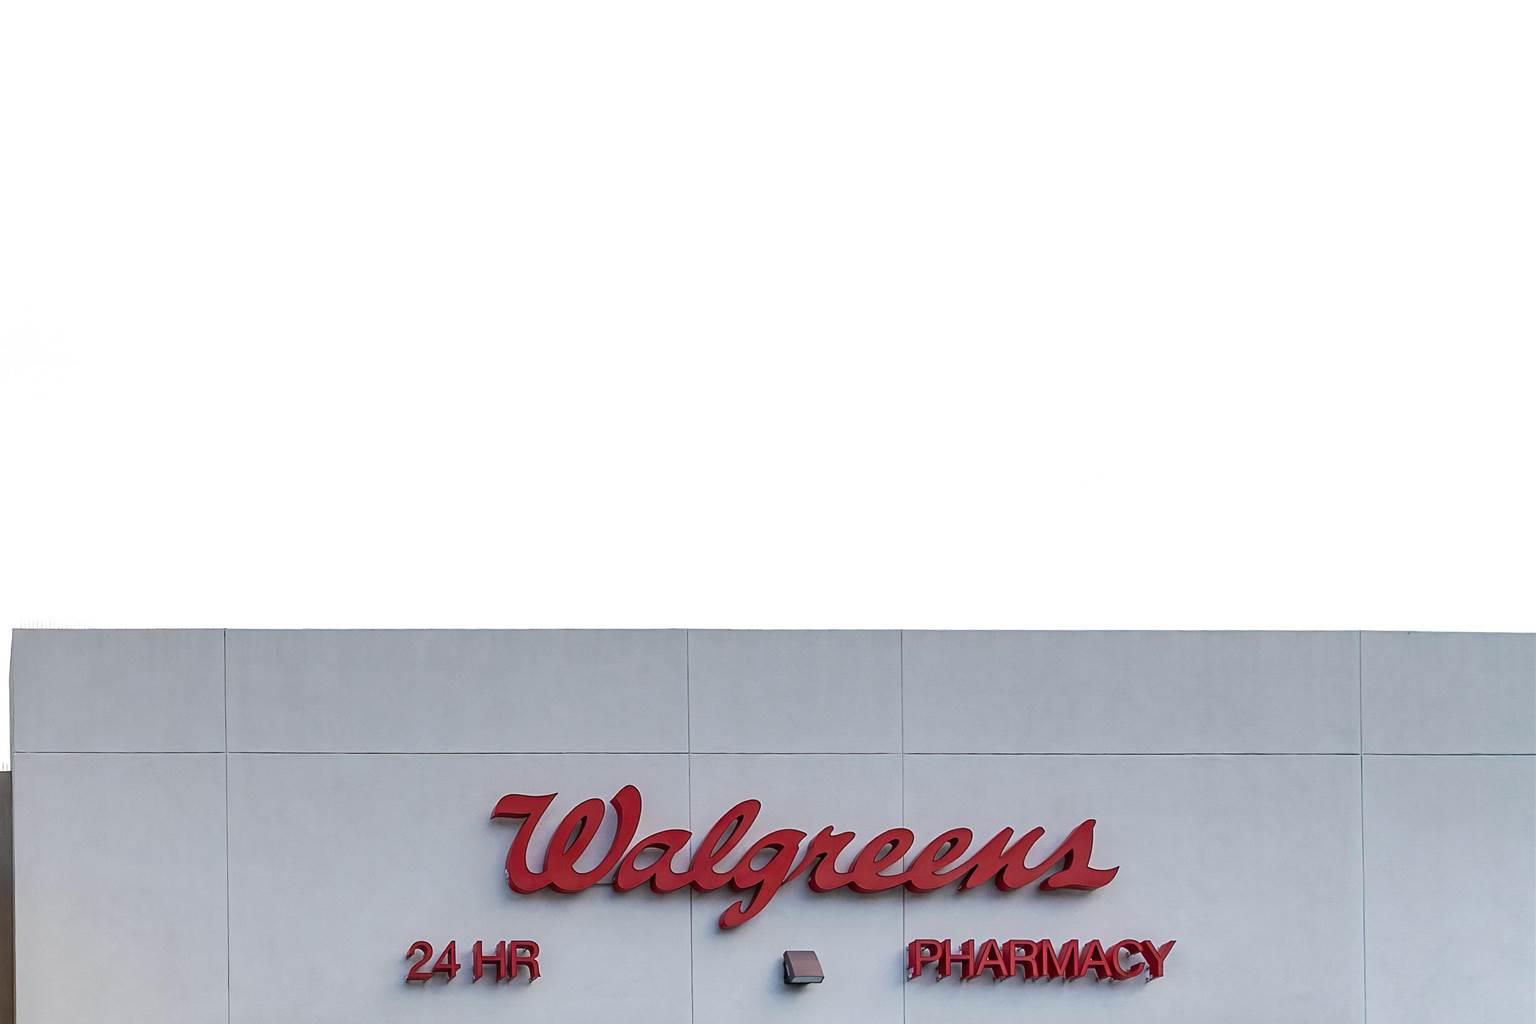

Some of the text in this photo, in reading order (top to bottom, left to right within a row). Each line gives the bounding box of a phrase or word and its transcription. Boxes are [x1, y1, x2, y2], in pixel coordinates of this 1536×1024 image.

[489, 784, 1121, 930] Walgreens
[406, 940, 542, 983] 24 HR
[906, 938, 1177, 983] PHARMACY
